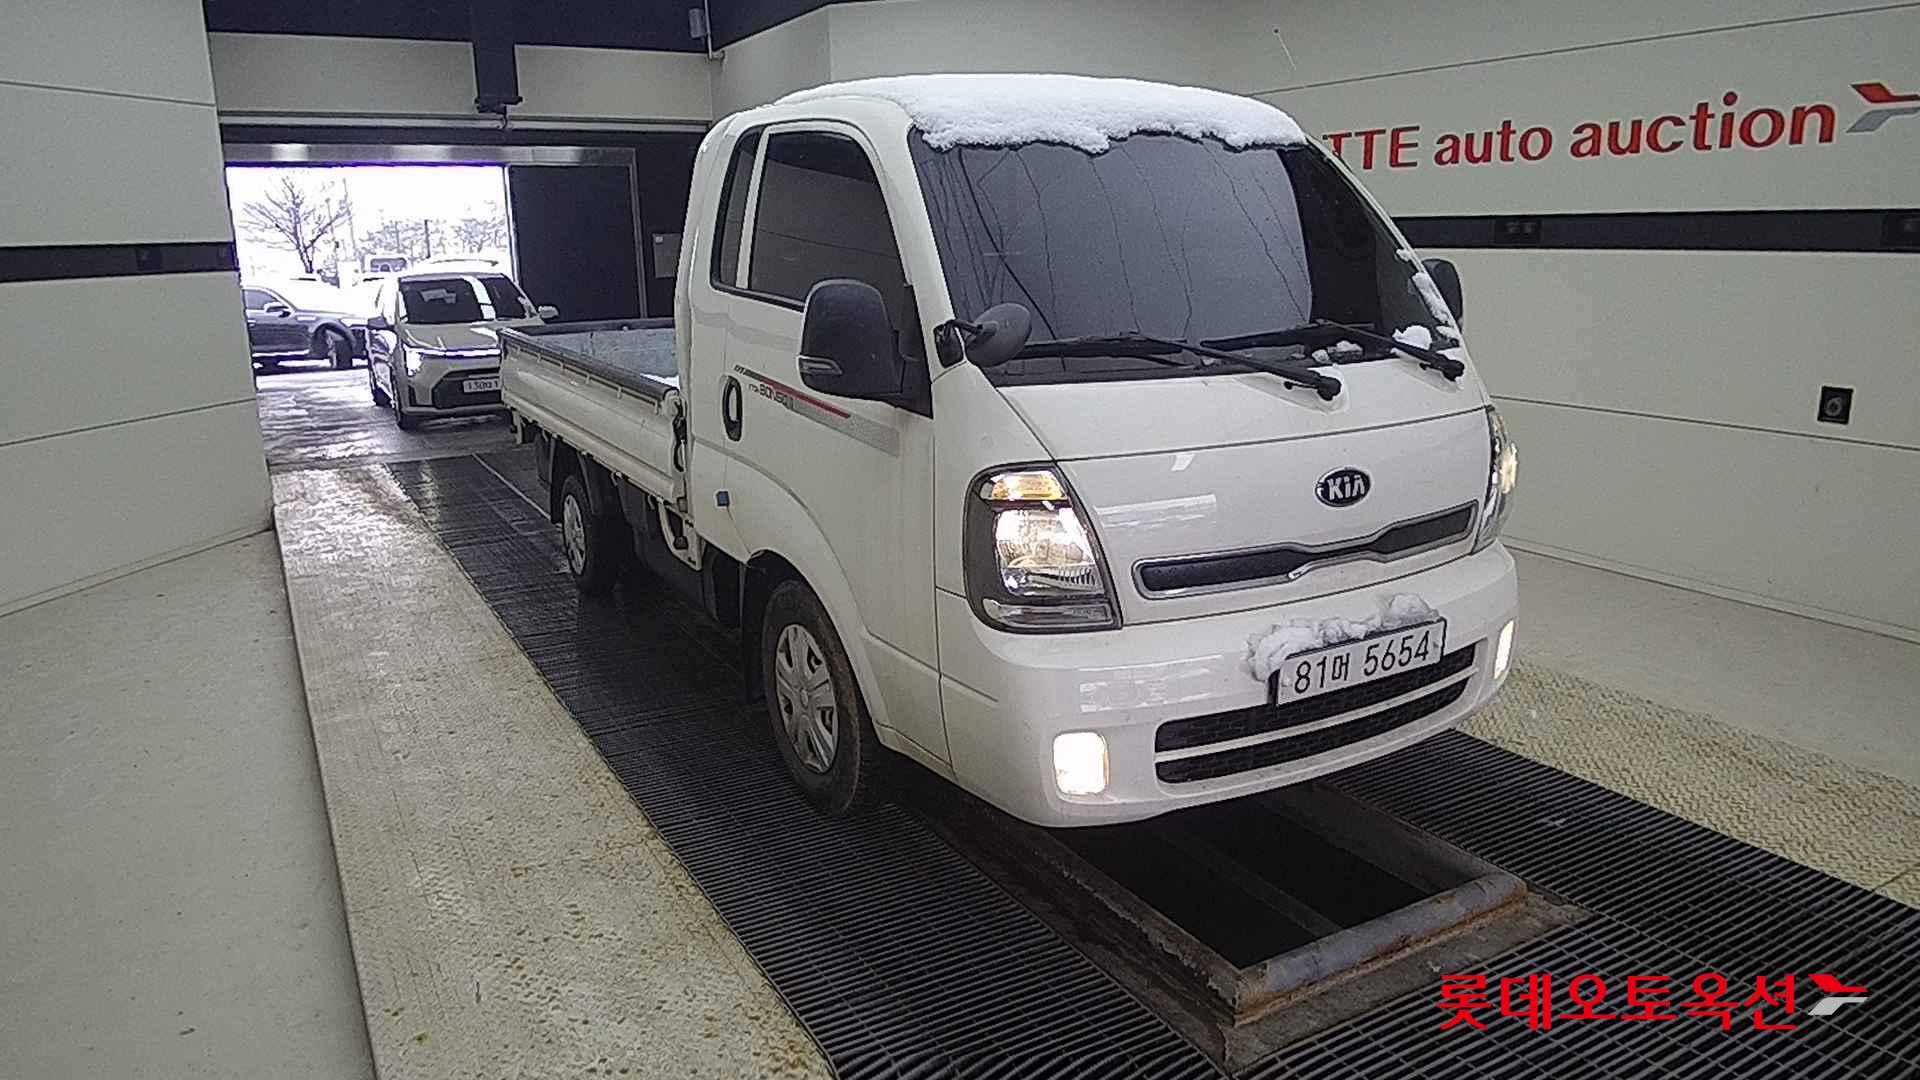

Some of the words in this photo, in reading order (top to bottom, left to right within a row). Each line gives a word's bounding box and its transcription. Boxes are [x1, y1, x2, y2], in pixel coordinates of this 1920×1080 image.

[1434, 119, 1553, 167] auto
[1570, 91, 1835, 159] auction
[1326, 474, 1366, 500] KIA
[1294, 652, 1351, 694] 81머
[1363, 630, 1430, 677] 5654
